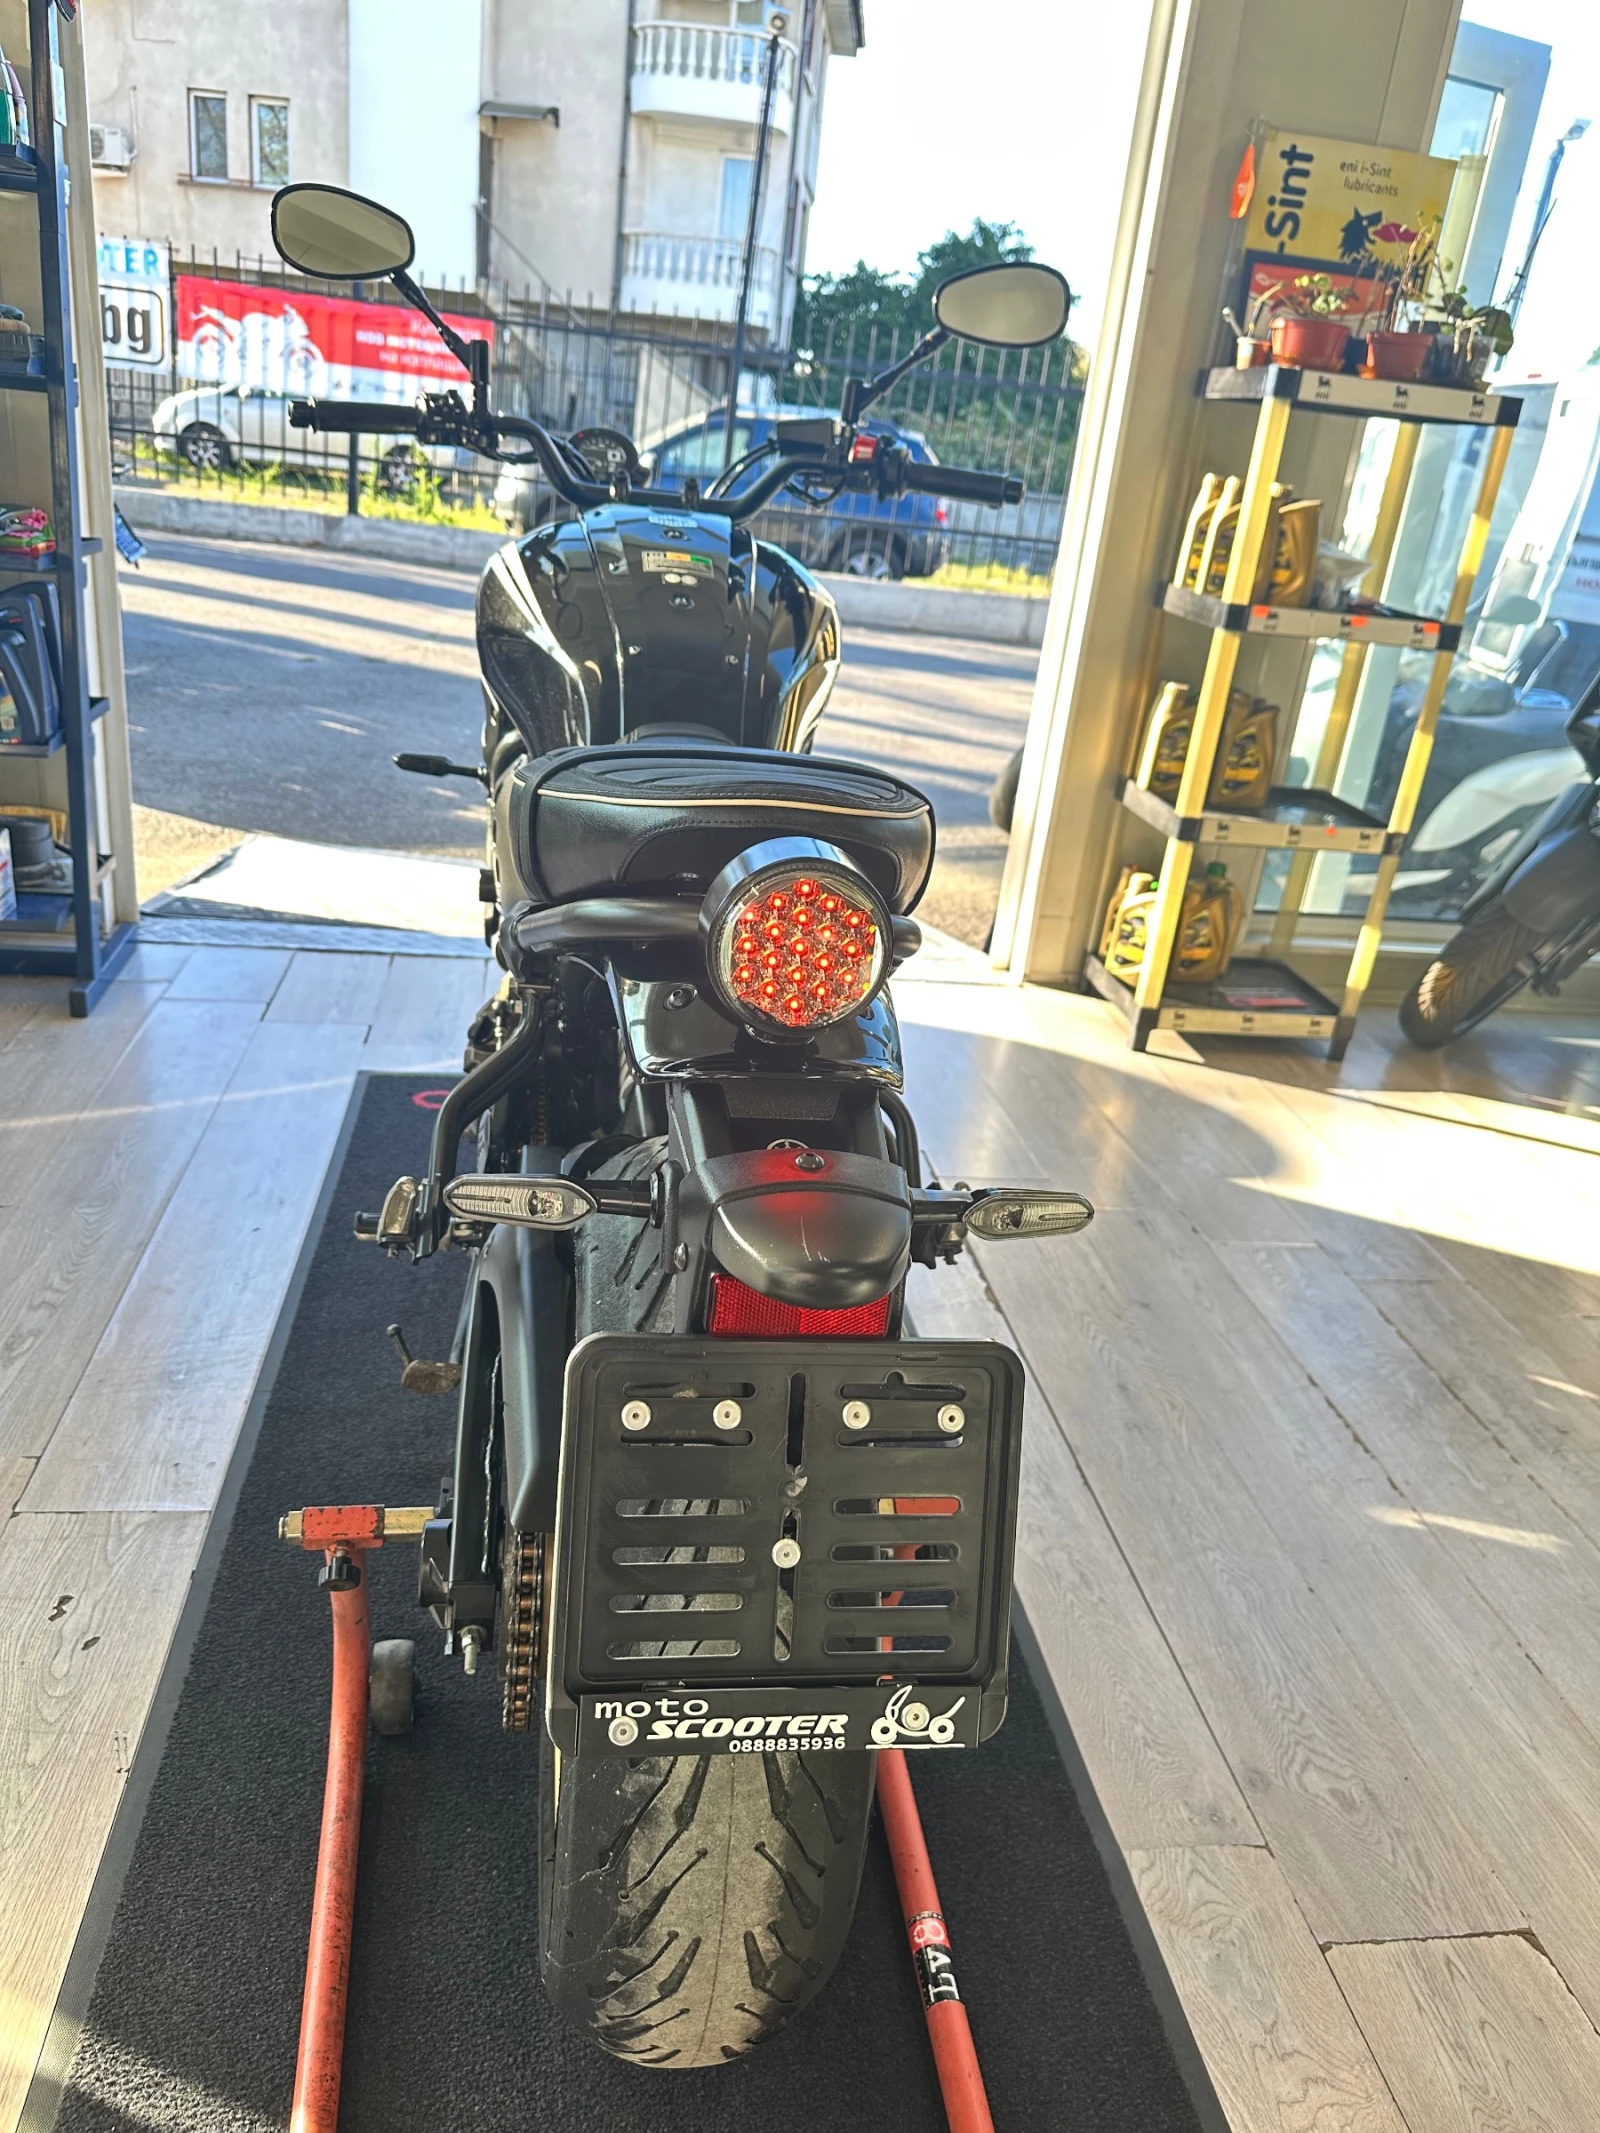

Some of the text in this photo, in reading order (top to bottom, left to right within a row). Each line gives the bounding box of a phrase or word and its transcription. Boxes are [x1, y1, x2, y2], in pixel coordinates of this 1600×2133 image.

[1339, 159, 1392, 179] eni i-Sint
[1343, 175, 1399, 197] lubricants
[594, 1698, 710, 1719] moto
[646, 1714, 849, 1740] SCOOTER
[728, 1737, 846, 1753] 0888835936
